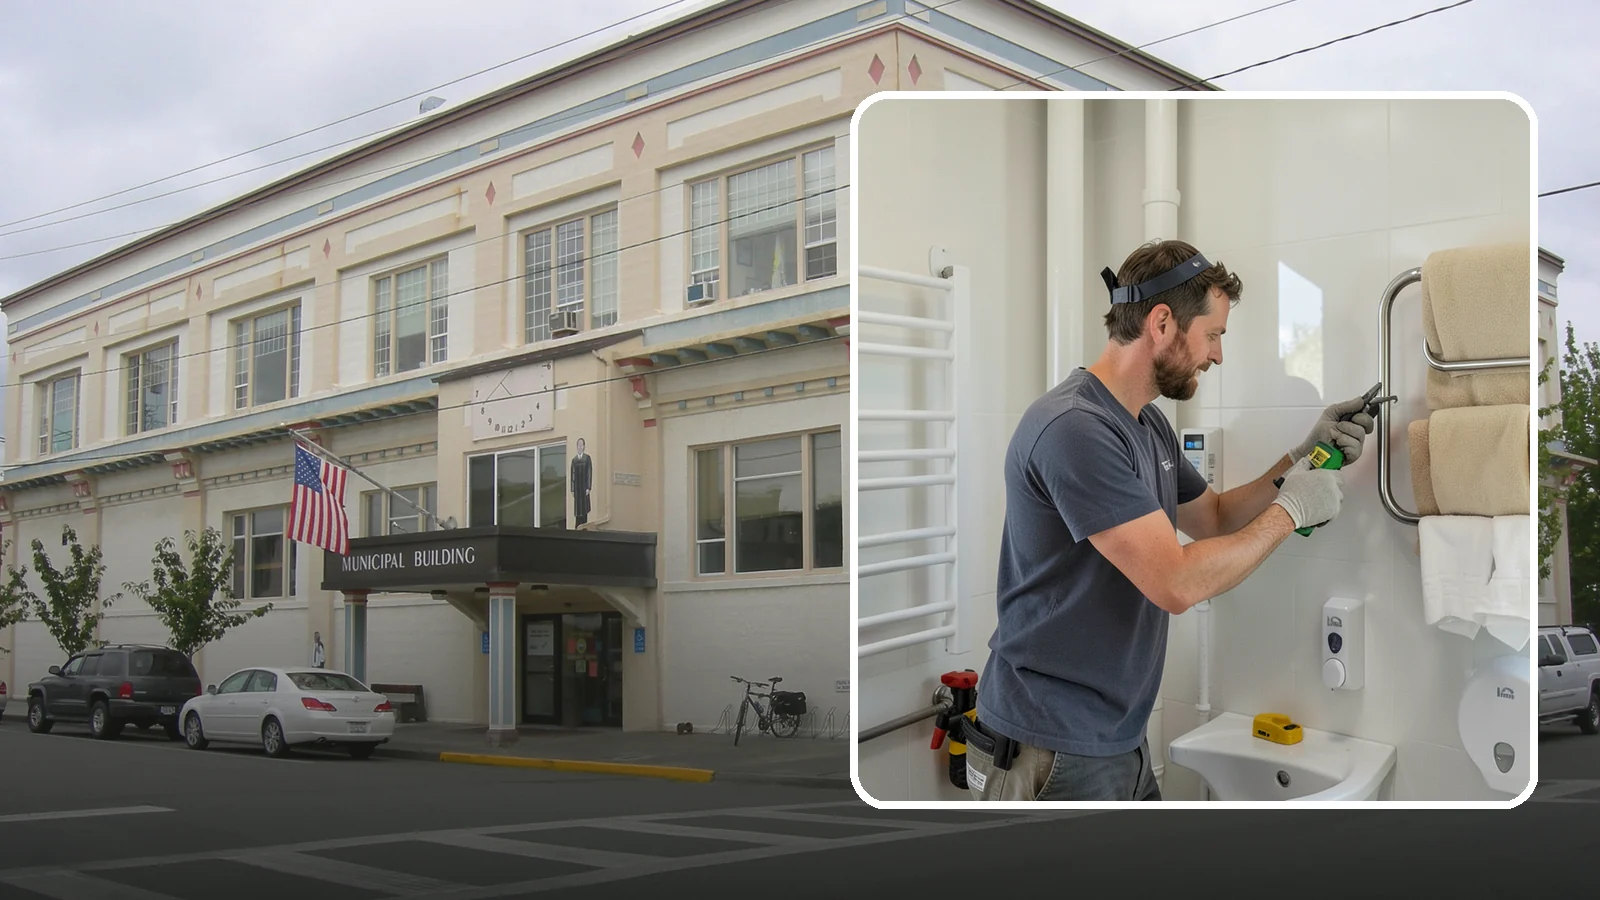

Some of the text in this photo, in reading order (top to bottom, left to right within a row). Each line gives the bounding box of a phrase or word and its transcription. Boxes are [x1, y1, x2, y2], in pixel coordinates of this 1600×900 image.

[488, 418, 492, 426] 9
[528, 414, 533, 422] 3
[342, 546, 475, 572] MUNICIPAL BUILDING
